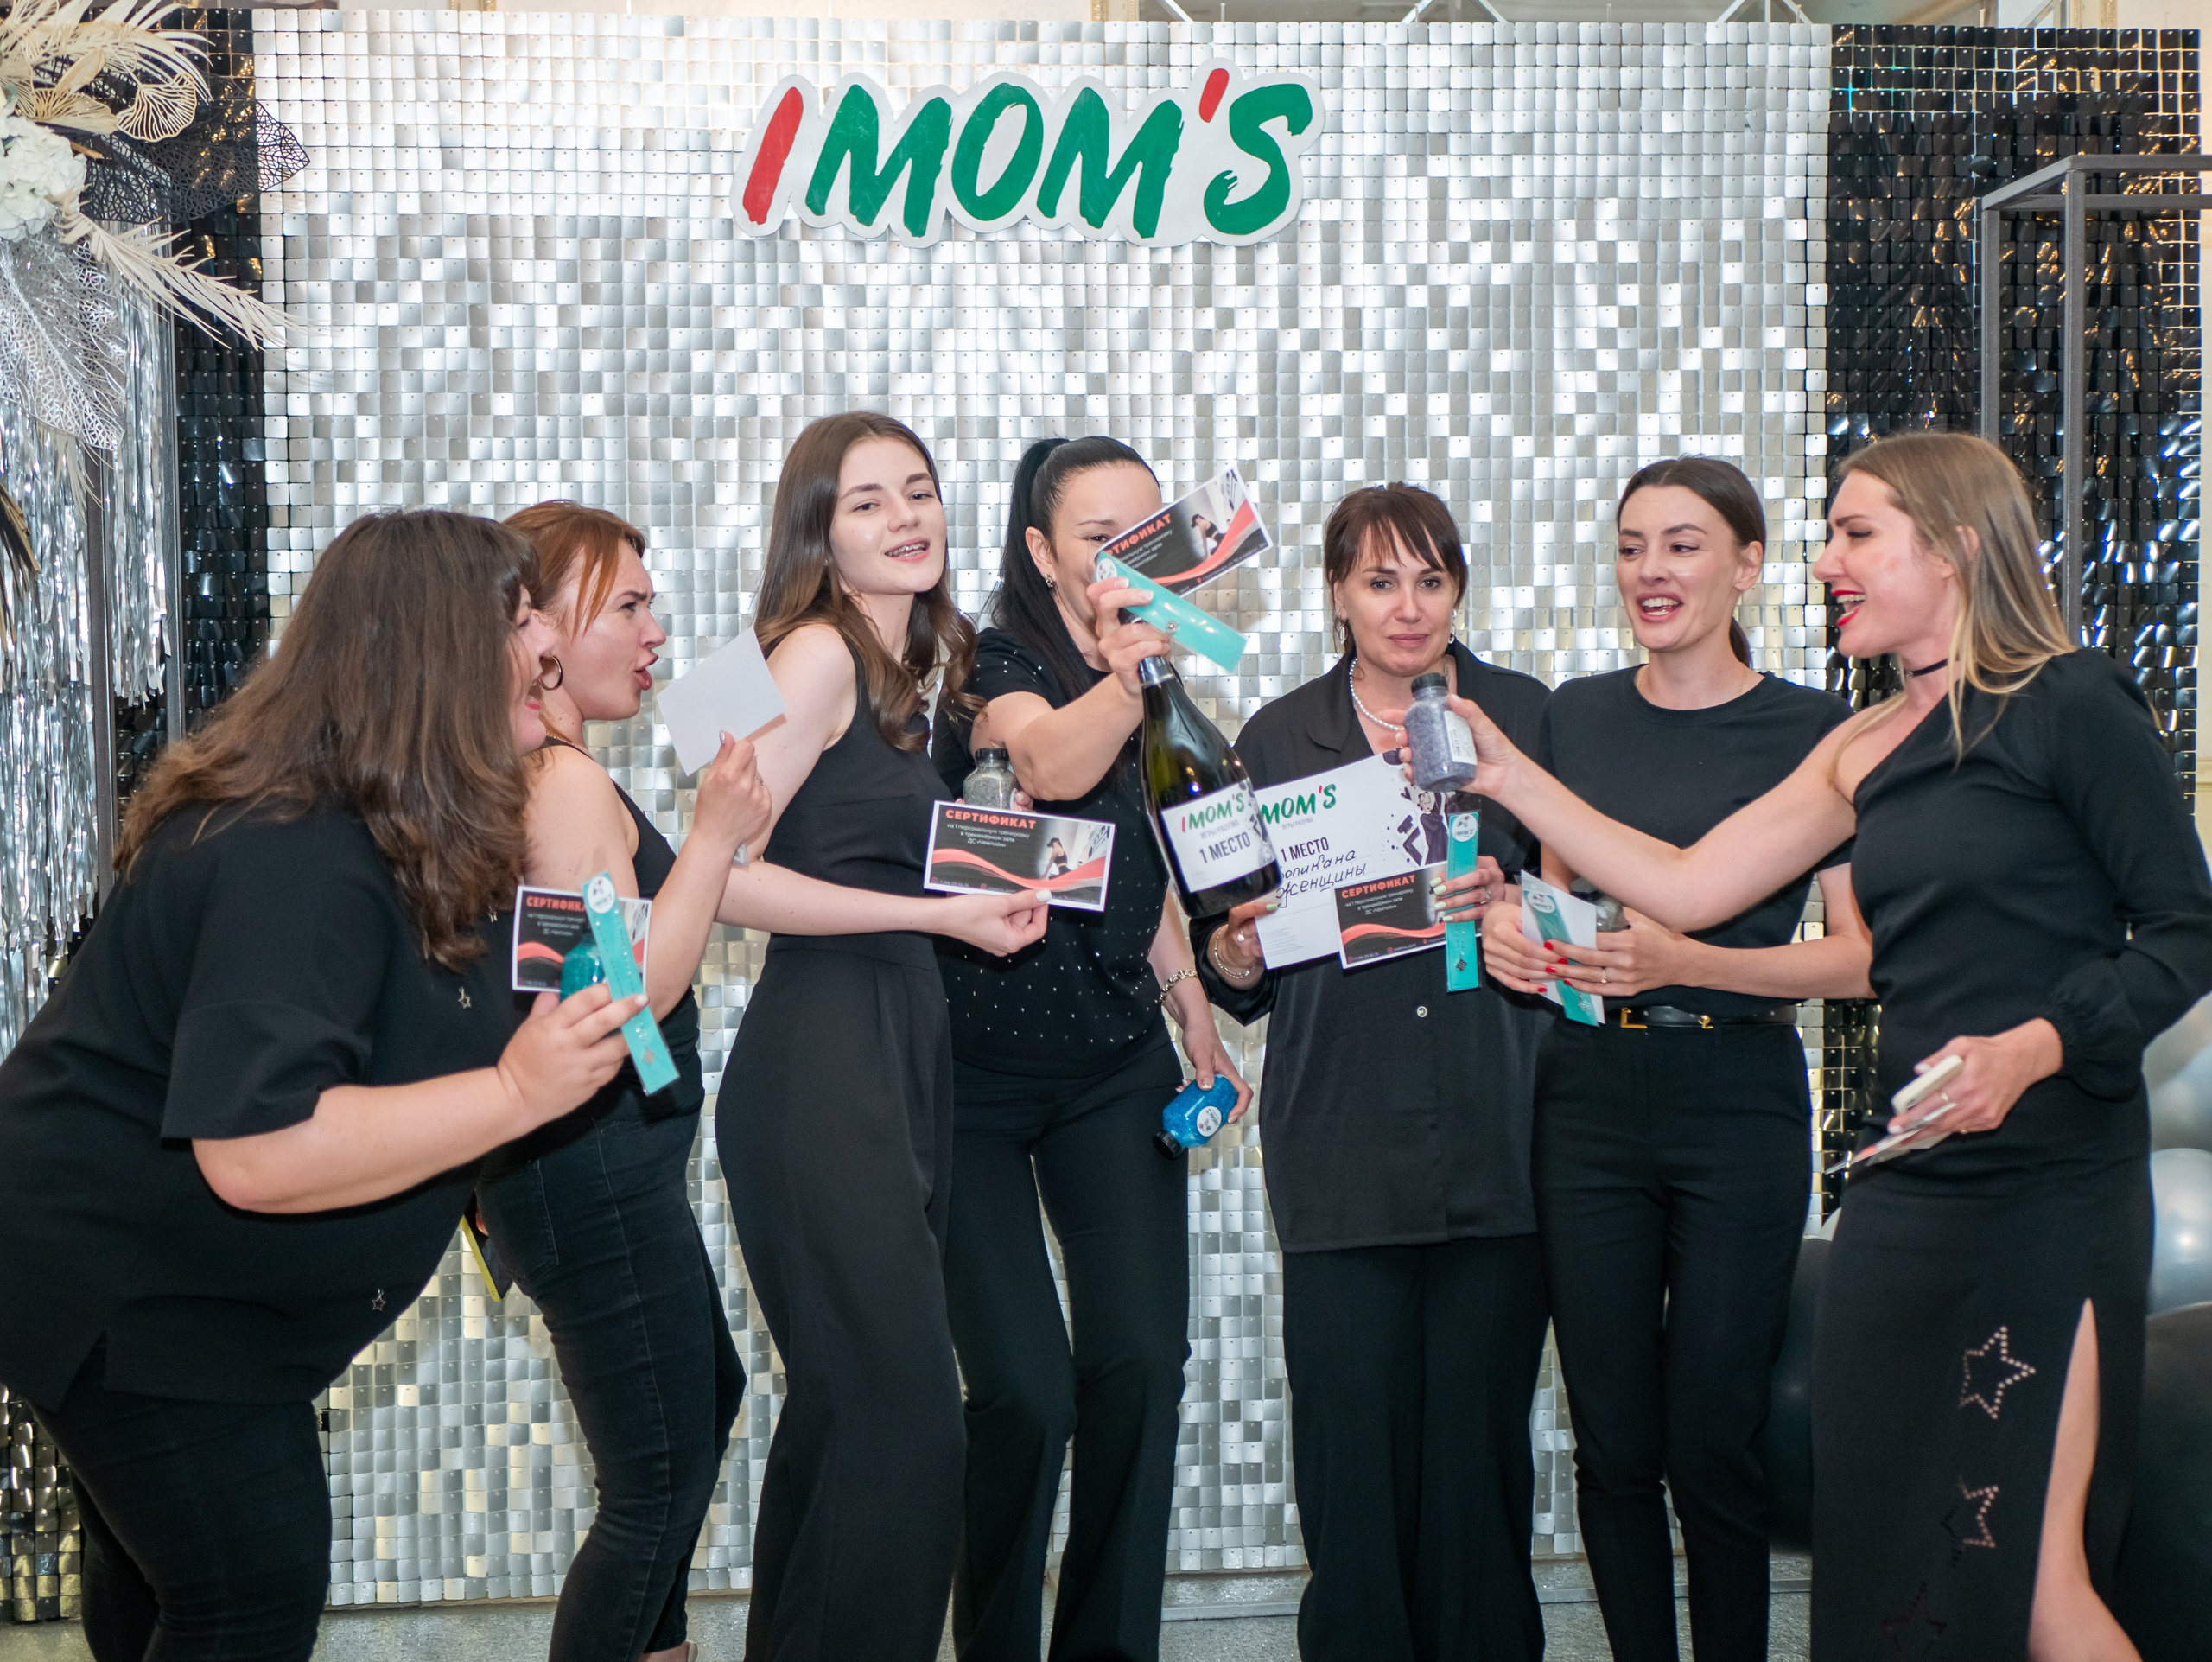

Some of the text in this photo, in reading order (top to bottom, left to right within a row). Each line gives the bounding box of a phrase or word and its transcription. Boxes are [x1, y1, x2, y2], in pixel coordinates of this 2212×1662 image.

[1106, 513, 1171, 555] РТИФИКАТ
[1261, 783, 1337, 824] MOM'S
[945, 809, 1037, 830] СЕРТИФИКАТ
[1200, 819, 1240, 840] ИГРЫ РАЗУМА
[1281, 817, 1313, 830] ИГРЫ РАЗУМА
[957, 825, 997, 835] персональную
[998, 830, 1030, 839] тренировку
[1199, 832, 1251, 864] 1 МЕСТО
[1281, 837, 1329, 863] 1 МЕСТО
[1341, 875, 1415, 899] СЕРТИФИКАТ
[526, 896, 585, 912] СЕРТИФИК
